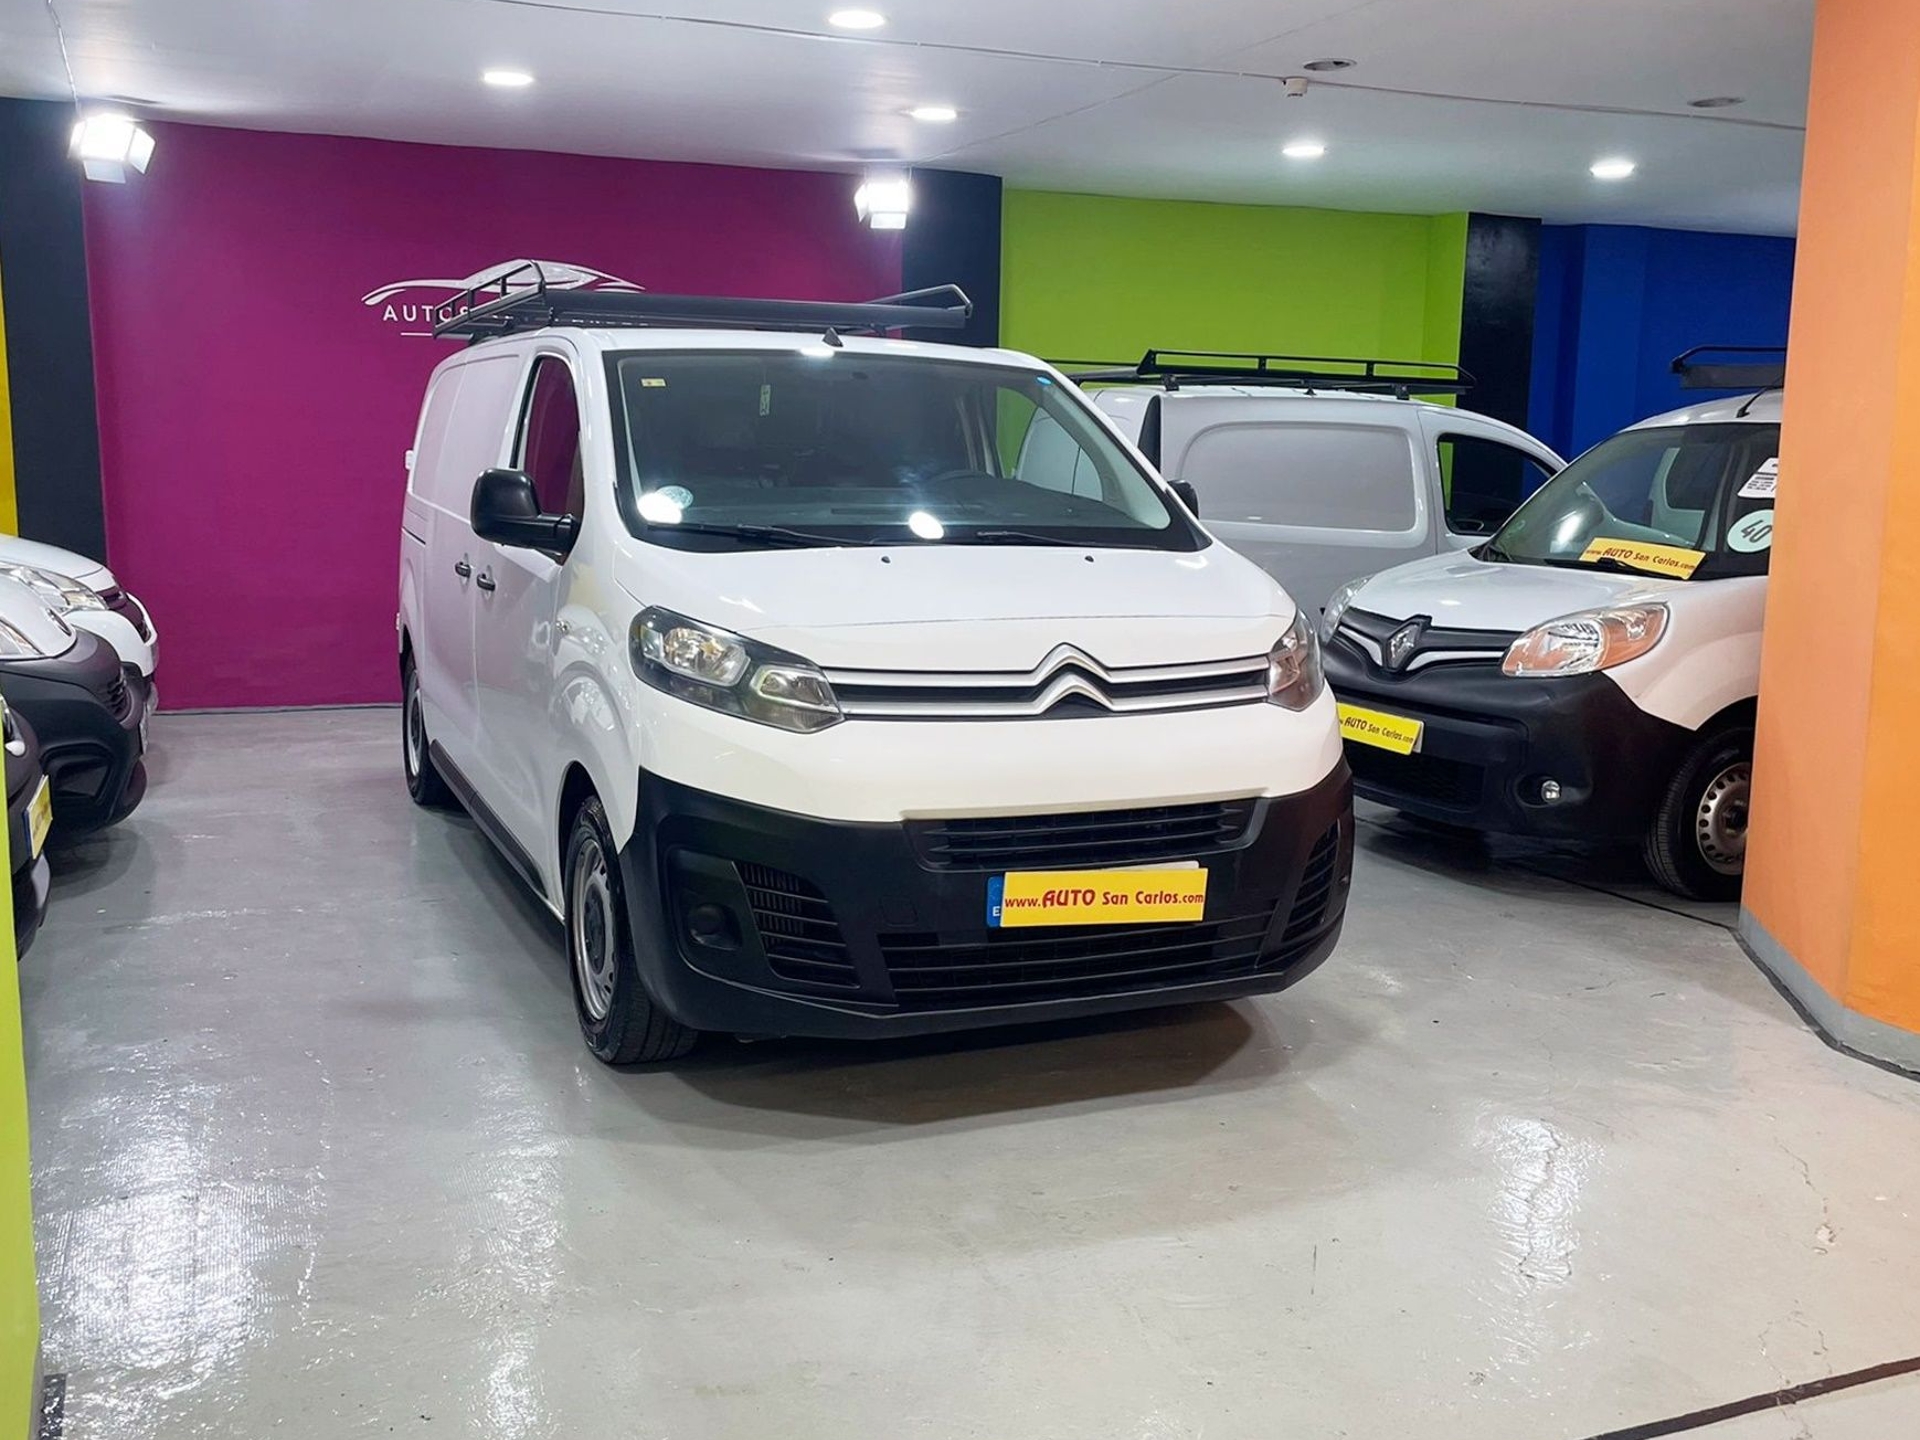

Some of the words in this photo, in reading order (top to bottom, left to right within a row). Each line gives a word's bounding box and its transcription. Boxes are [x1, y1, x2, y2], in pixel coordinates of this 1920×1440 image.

[1741, 519, 1773, 543] 40
[1634, 552, 1650, 562] San
[1367, 723, 1381, 734] San
[1005, 889, 1095, 908] www.AUTO
[1102, 891, 1128, 906] San
[1135, 890, 1204, 905] Carlos.com
[992, 905, 1001, 917] E
